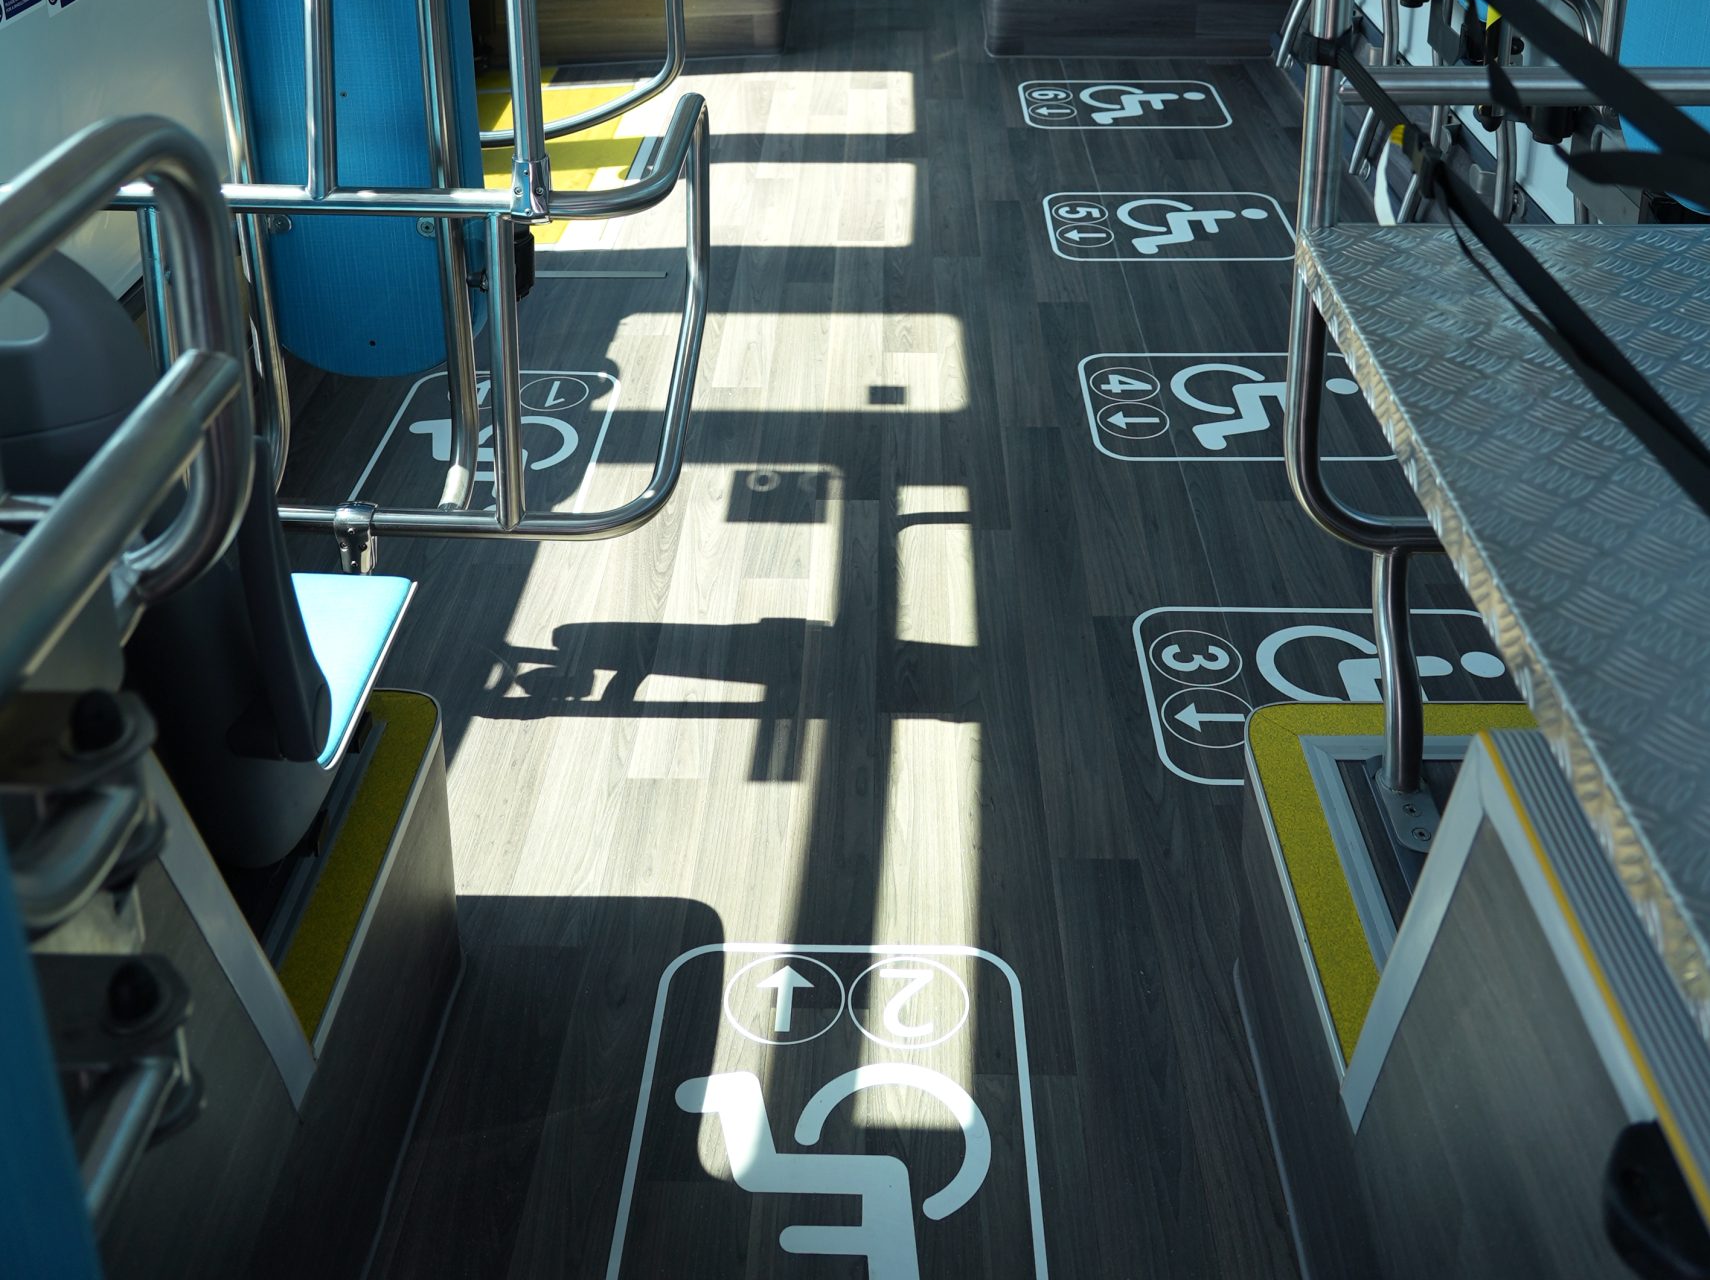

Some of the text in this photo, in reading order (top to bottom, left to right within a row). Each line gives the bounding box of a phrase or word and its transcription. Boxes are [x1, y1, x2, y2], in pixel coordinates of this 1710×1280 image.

[1031, 90, 1067, 100] 6
[1058, 206, 1101, 219] 5
[544, 381, 566, 407] 1
[1101, 374, 1153, 393] 4
[1161, 644, 1230, 672] 3
[879, 968, 934, 1038] 2
